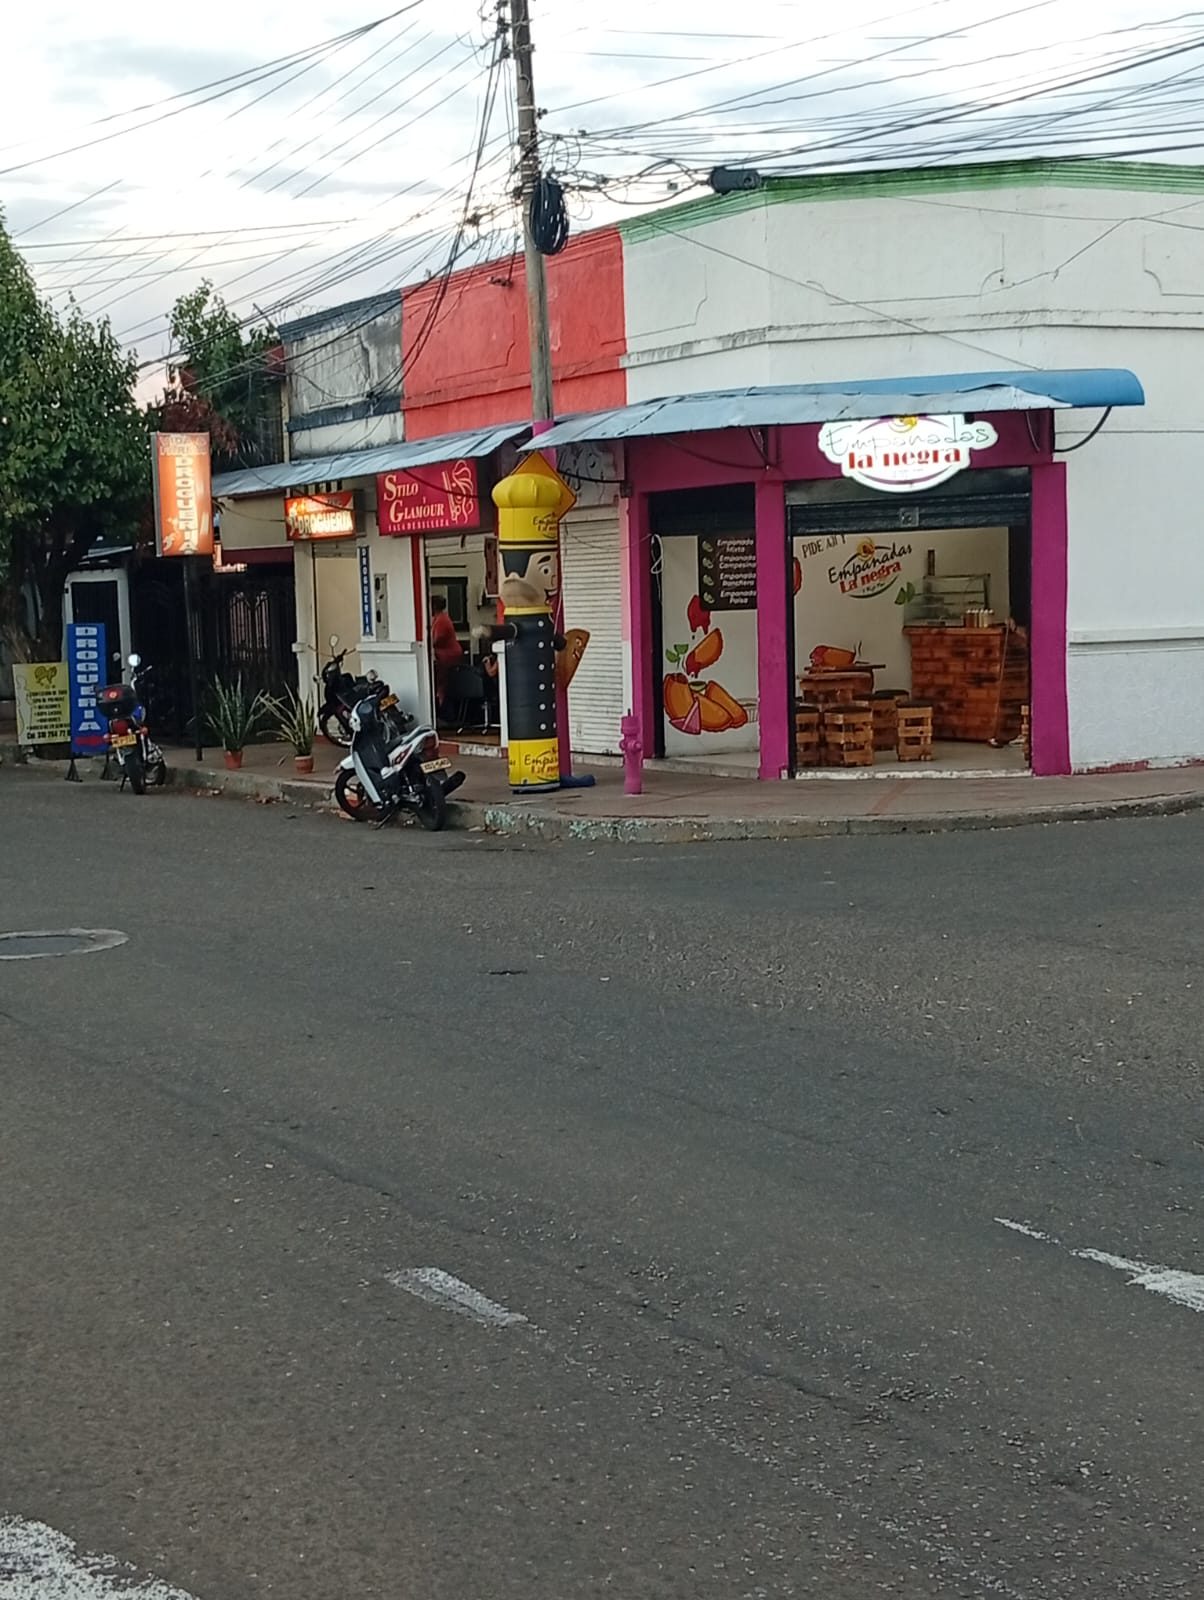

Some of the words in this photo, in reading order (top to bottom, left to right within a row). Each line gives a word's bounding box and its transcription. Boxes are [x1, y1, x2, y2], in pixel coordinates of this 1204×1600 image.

[826, 416, 989, 458] Empanadas
[883, 448, 961, 467] negra
[801, 539, 824, 558] PIDE
[828, 541, 912, 584] Empanadas
[860, 561, 902, 586] negra
[76, 626, 101, 731] DROGUERIA
